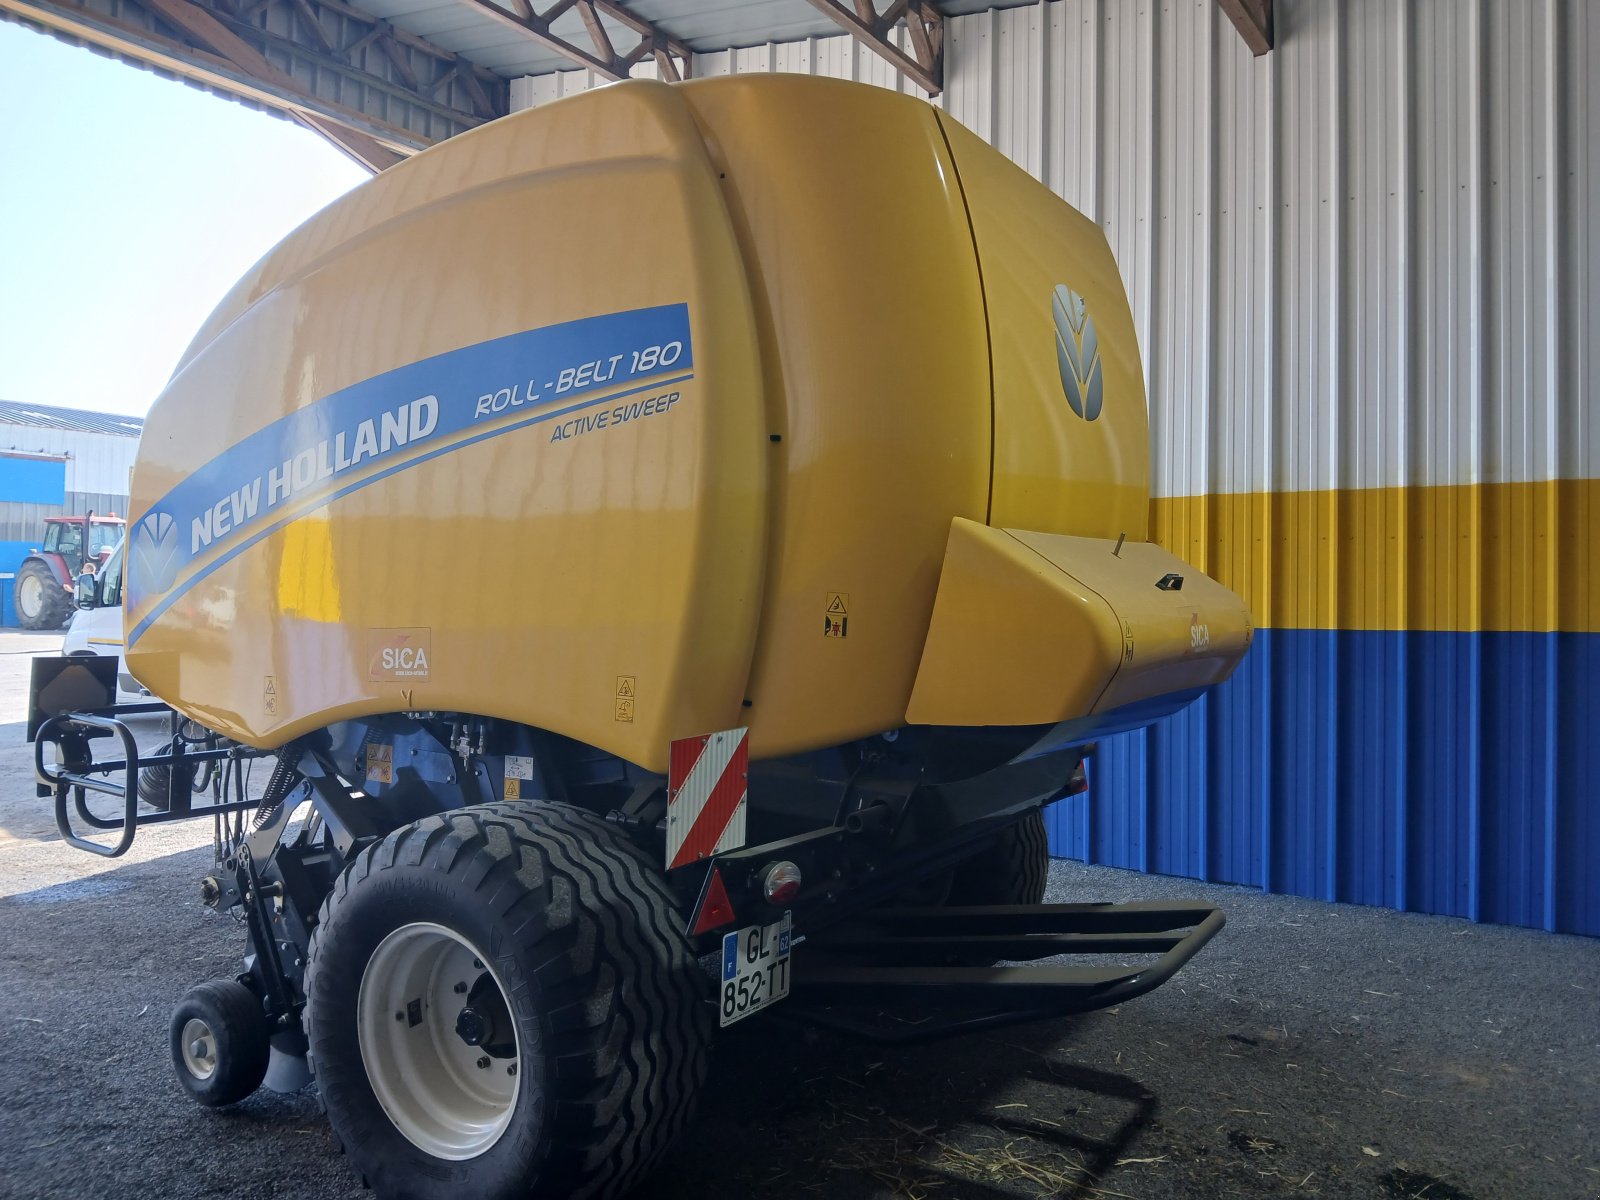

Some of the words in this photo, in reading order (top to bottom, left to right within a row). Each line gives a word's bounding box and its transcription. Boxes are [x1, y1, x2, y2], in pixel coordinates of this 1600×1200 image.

[630, 340, 682, 375] 180
[550, 410, 610, 444] ACTIVE
[611, 391, 681, 426] SWEEP
[191, 477, 262, 555] NEW
[268, 394, 439, 508] HOLLAND
[1190, 624, 1210, 647] SICA
[382, 647, 428, 669] SICA
[780, 935, 789, 951] 62
[727, 961, 733, 973] F
[723, 956, 789, 1018] 852-TT
